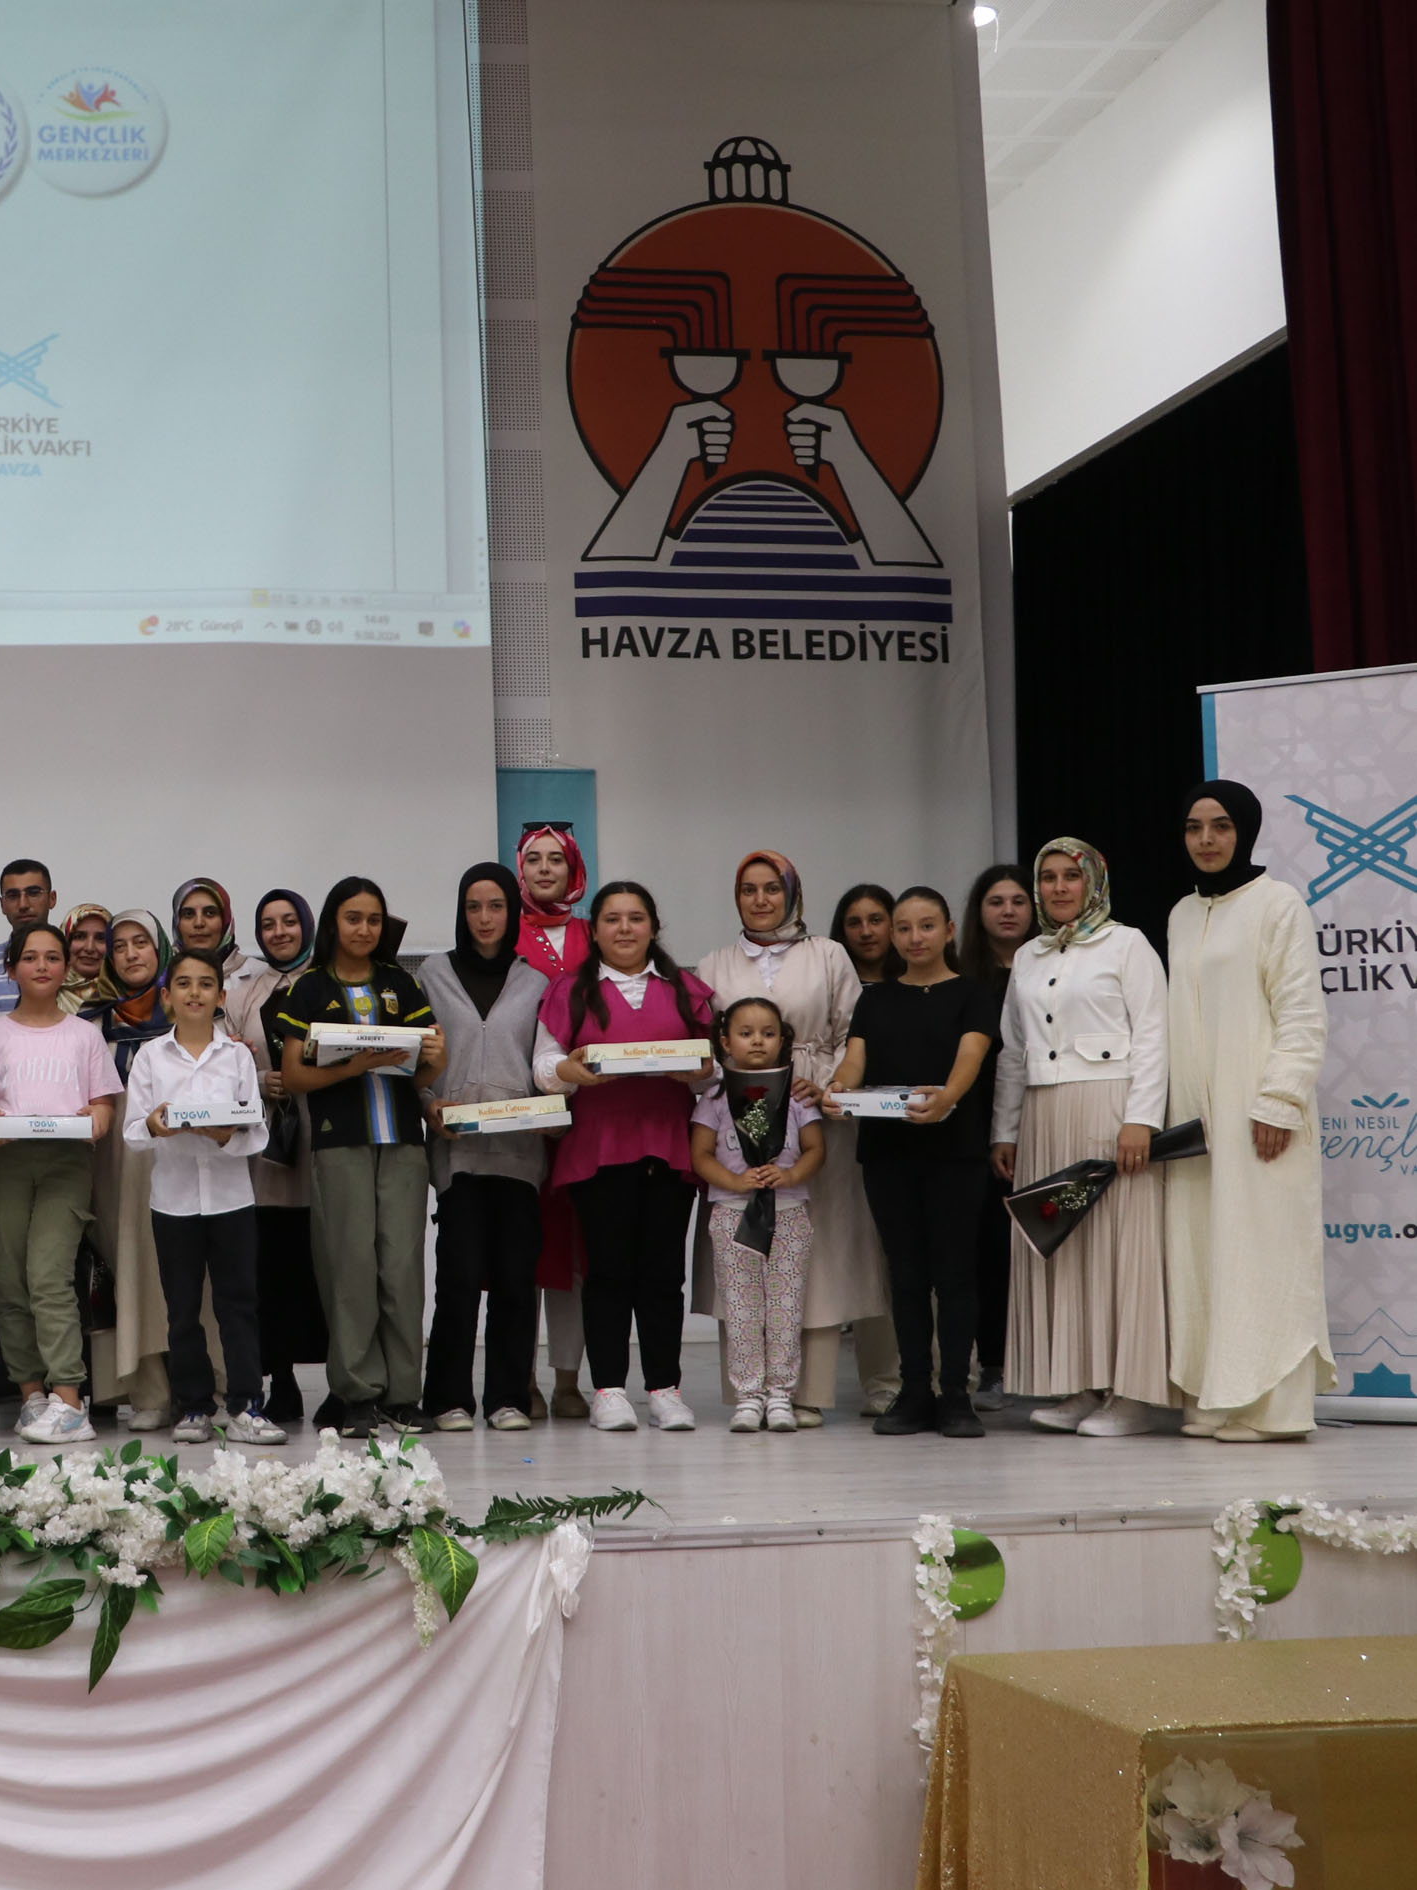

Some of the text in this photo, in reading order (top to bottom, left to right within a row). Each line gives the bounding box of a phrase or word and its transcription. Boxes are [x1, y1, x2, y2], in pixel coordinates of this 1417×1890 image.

[37, 124, 146, 147] GENÇLİK
[27, 440, 92, 457] VAKFI
[582, 623, 950, 663] HAVZA BELEDİYESİ
[1316, 920, 1417, 957] ÜRKİY
[1320, 958, 1394, 995] ÇLİK
[1324, 1223, 1417, 1244] ugva.o
